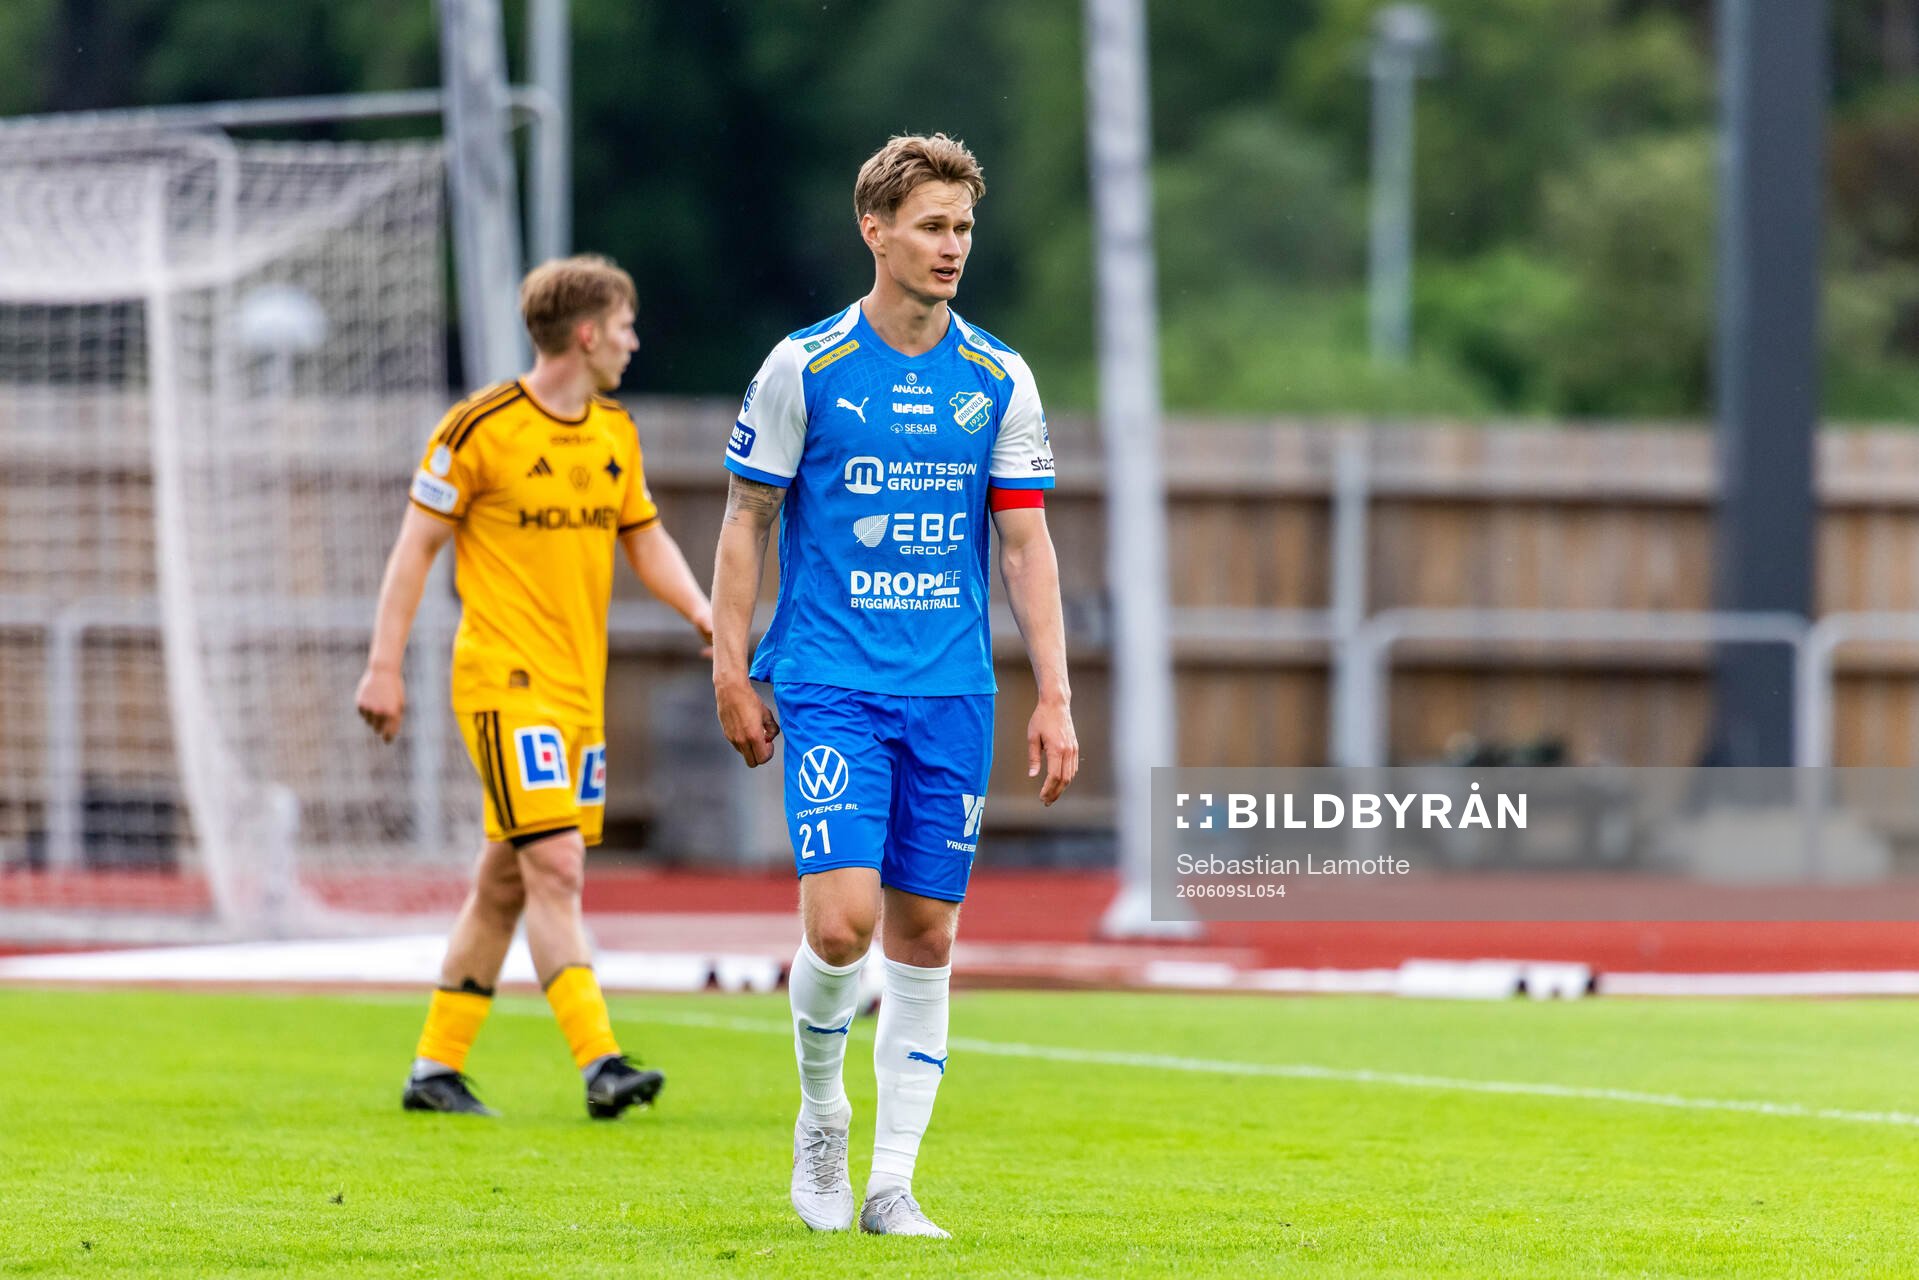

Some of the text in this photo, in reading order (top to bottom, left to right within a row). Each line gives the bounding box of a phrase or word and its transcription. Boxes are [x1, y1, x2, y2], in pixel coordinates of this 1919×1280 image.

[892, 384, 933, 395] ANACKA
[892, 402, 934, 415] UFAB
[957, 396, 984, 422] ODDEVOLD
[969, 412, 984, 427] 1932
[904, 423, 938, 433] SESAB
[888, 461, 977, 476] MATTSSON
[887, 477, 963, 492] GRUPPEN
[519, 506, 620, 531] HOLME
[892, 512, 967, 543] EBC
[899, 544, 958, 556] GROUP
[850, 596, 961, 611] BYGGMÄSTARTRALL
[796, 802, 859, 820] TOVEKS BIL
[799, 819, 832, 860] 21
